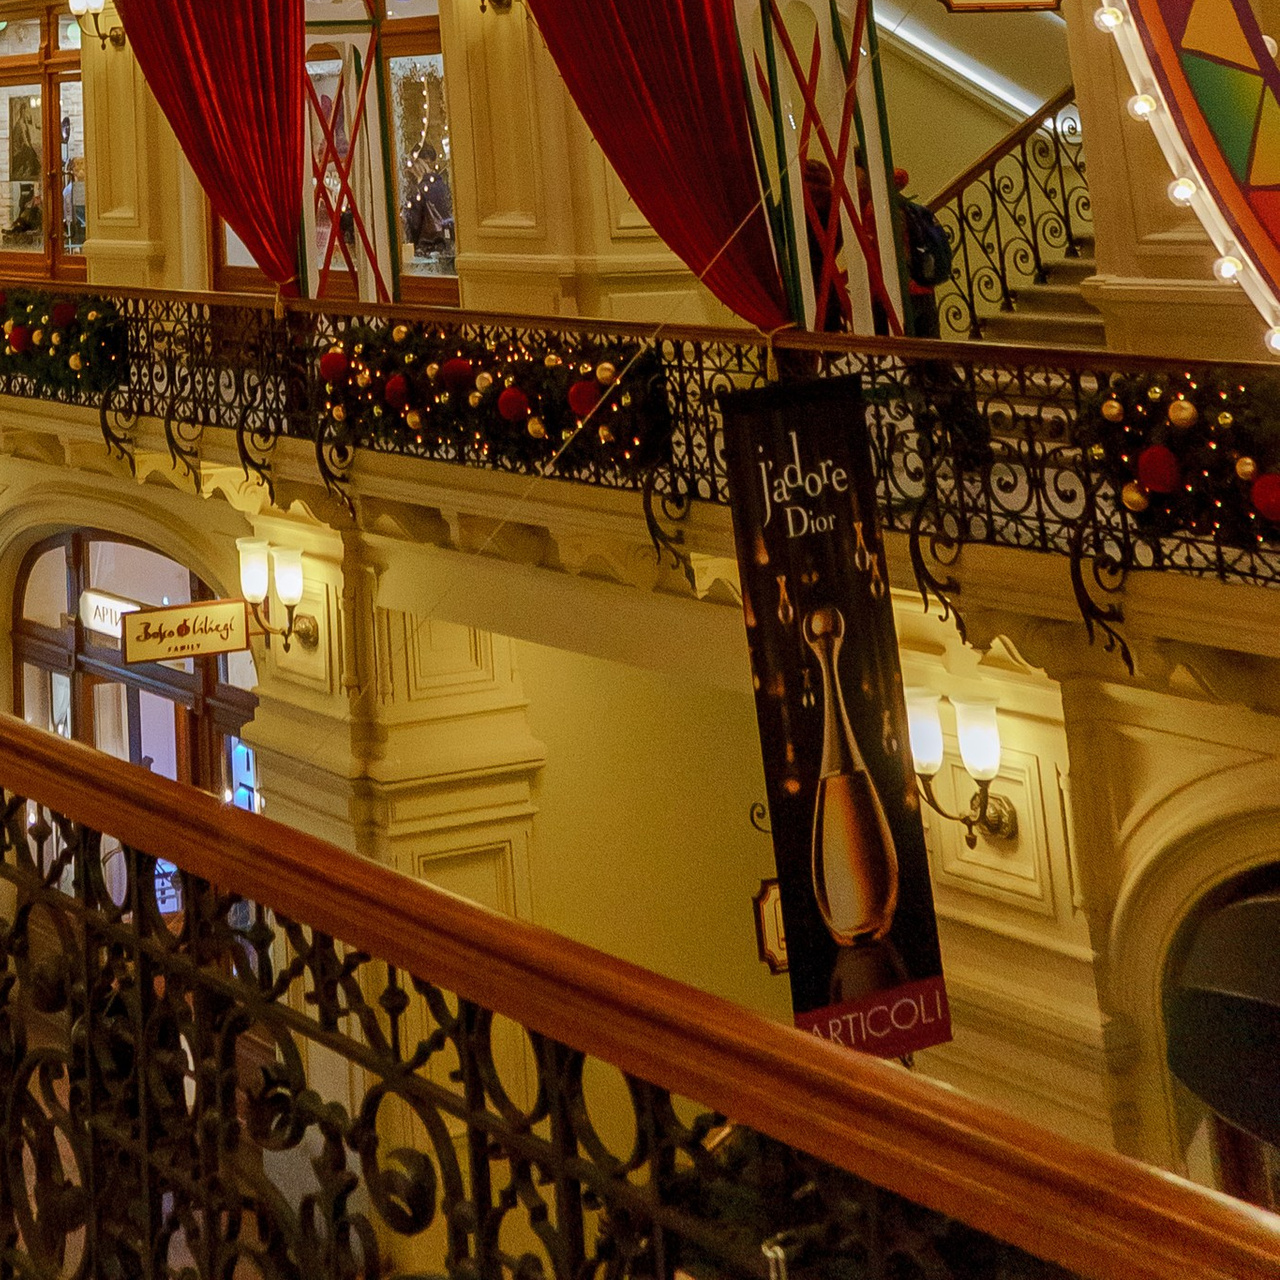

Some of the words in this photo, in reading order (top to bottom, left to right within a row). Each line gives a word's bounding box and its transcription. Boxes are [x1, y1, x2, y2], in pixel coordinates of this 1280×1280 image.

[758, 430, 849, 528] j'adore
[784, 506, 837, 538] Dior
[167, 643, 202, 653] FAMILY
